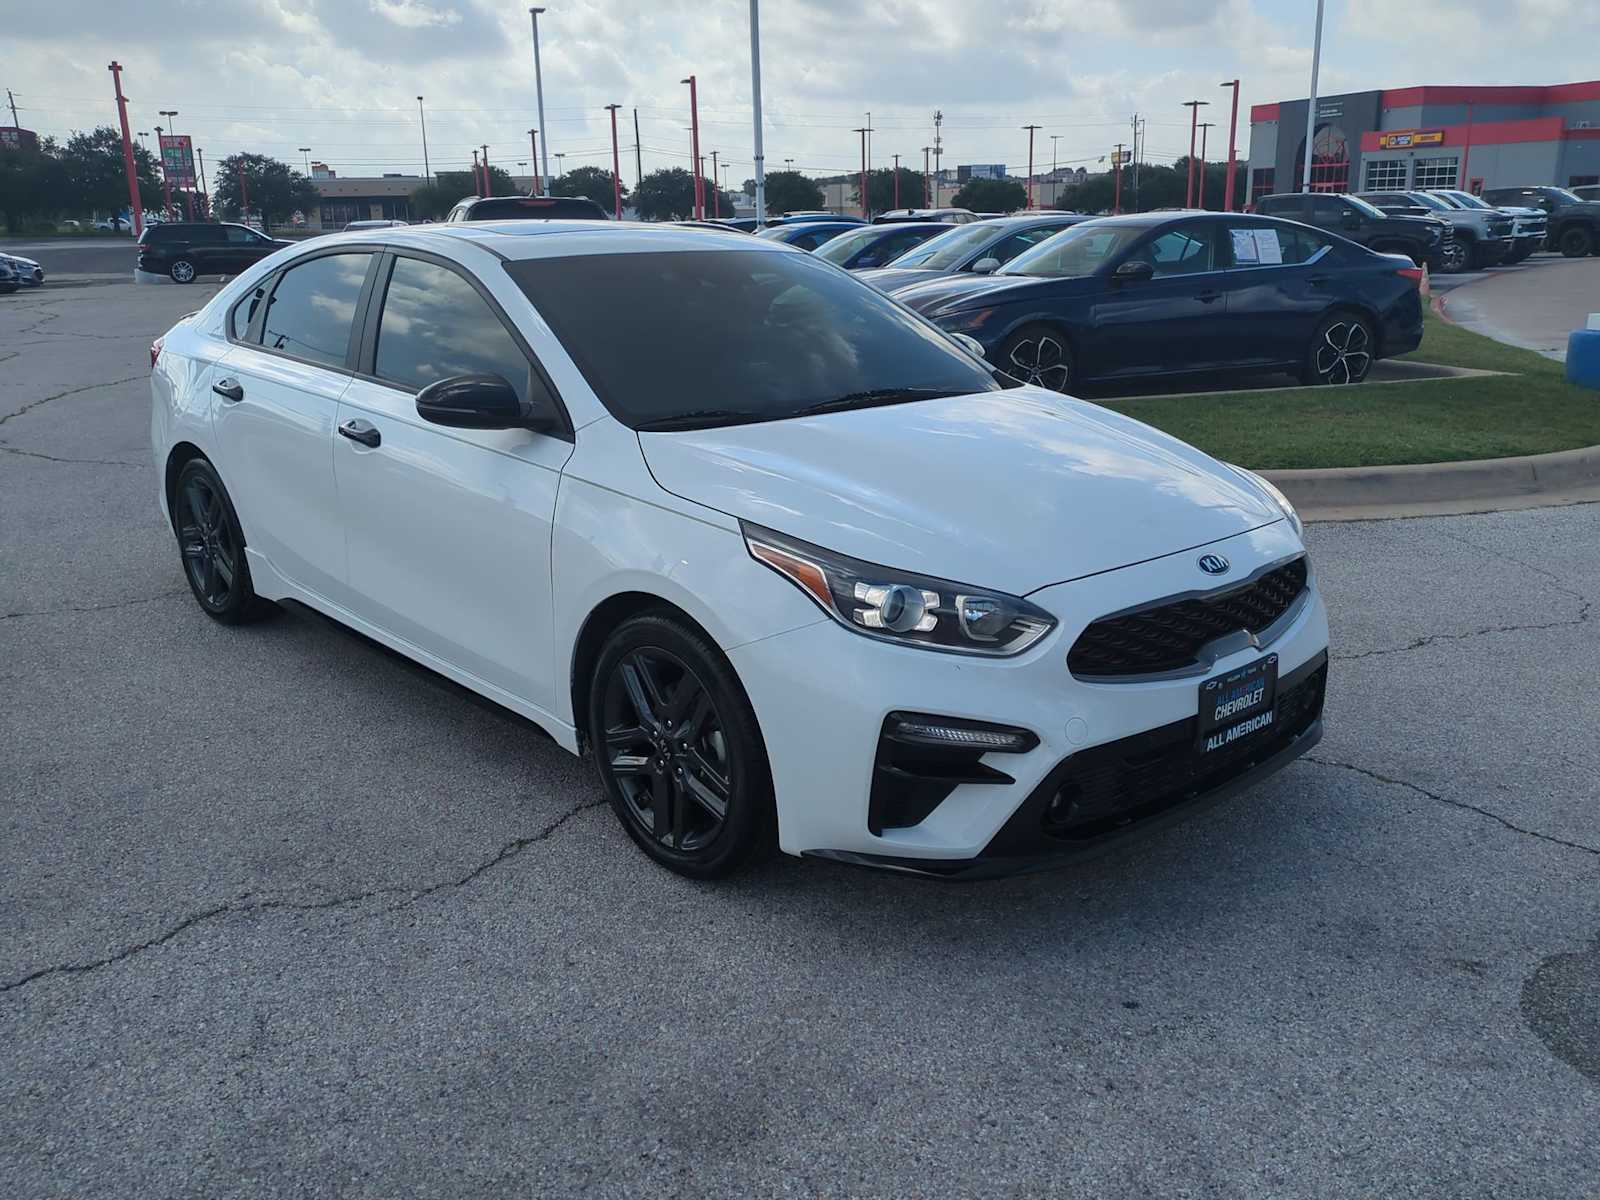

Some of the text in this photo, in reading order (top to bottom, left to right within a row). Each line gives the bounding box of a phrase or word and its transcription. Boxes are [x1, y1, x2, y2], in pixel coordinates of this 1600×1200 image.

[1201, 556, 1229, 572] KIA
[1215, 687, 1265, 721] CHEVROLET
[1206, 711, 1273, 752] ALL AMERICAN
